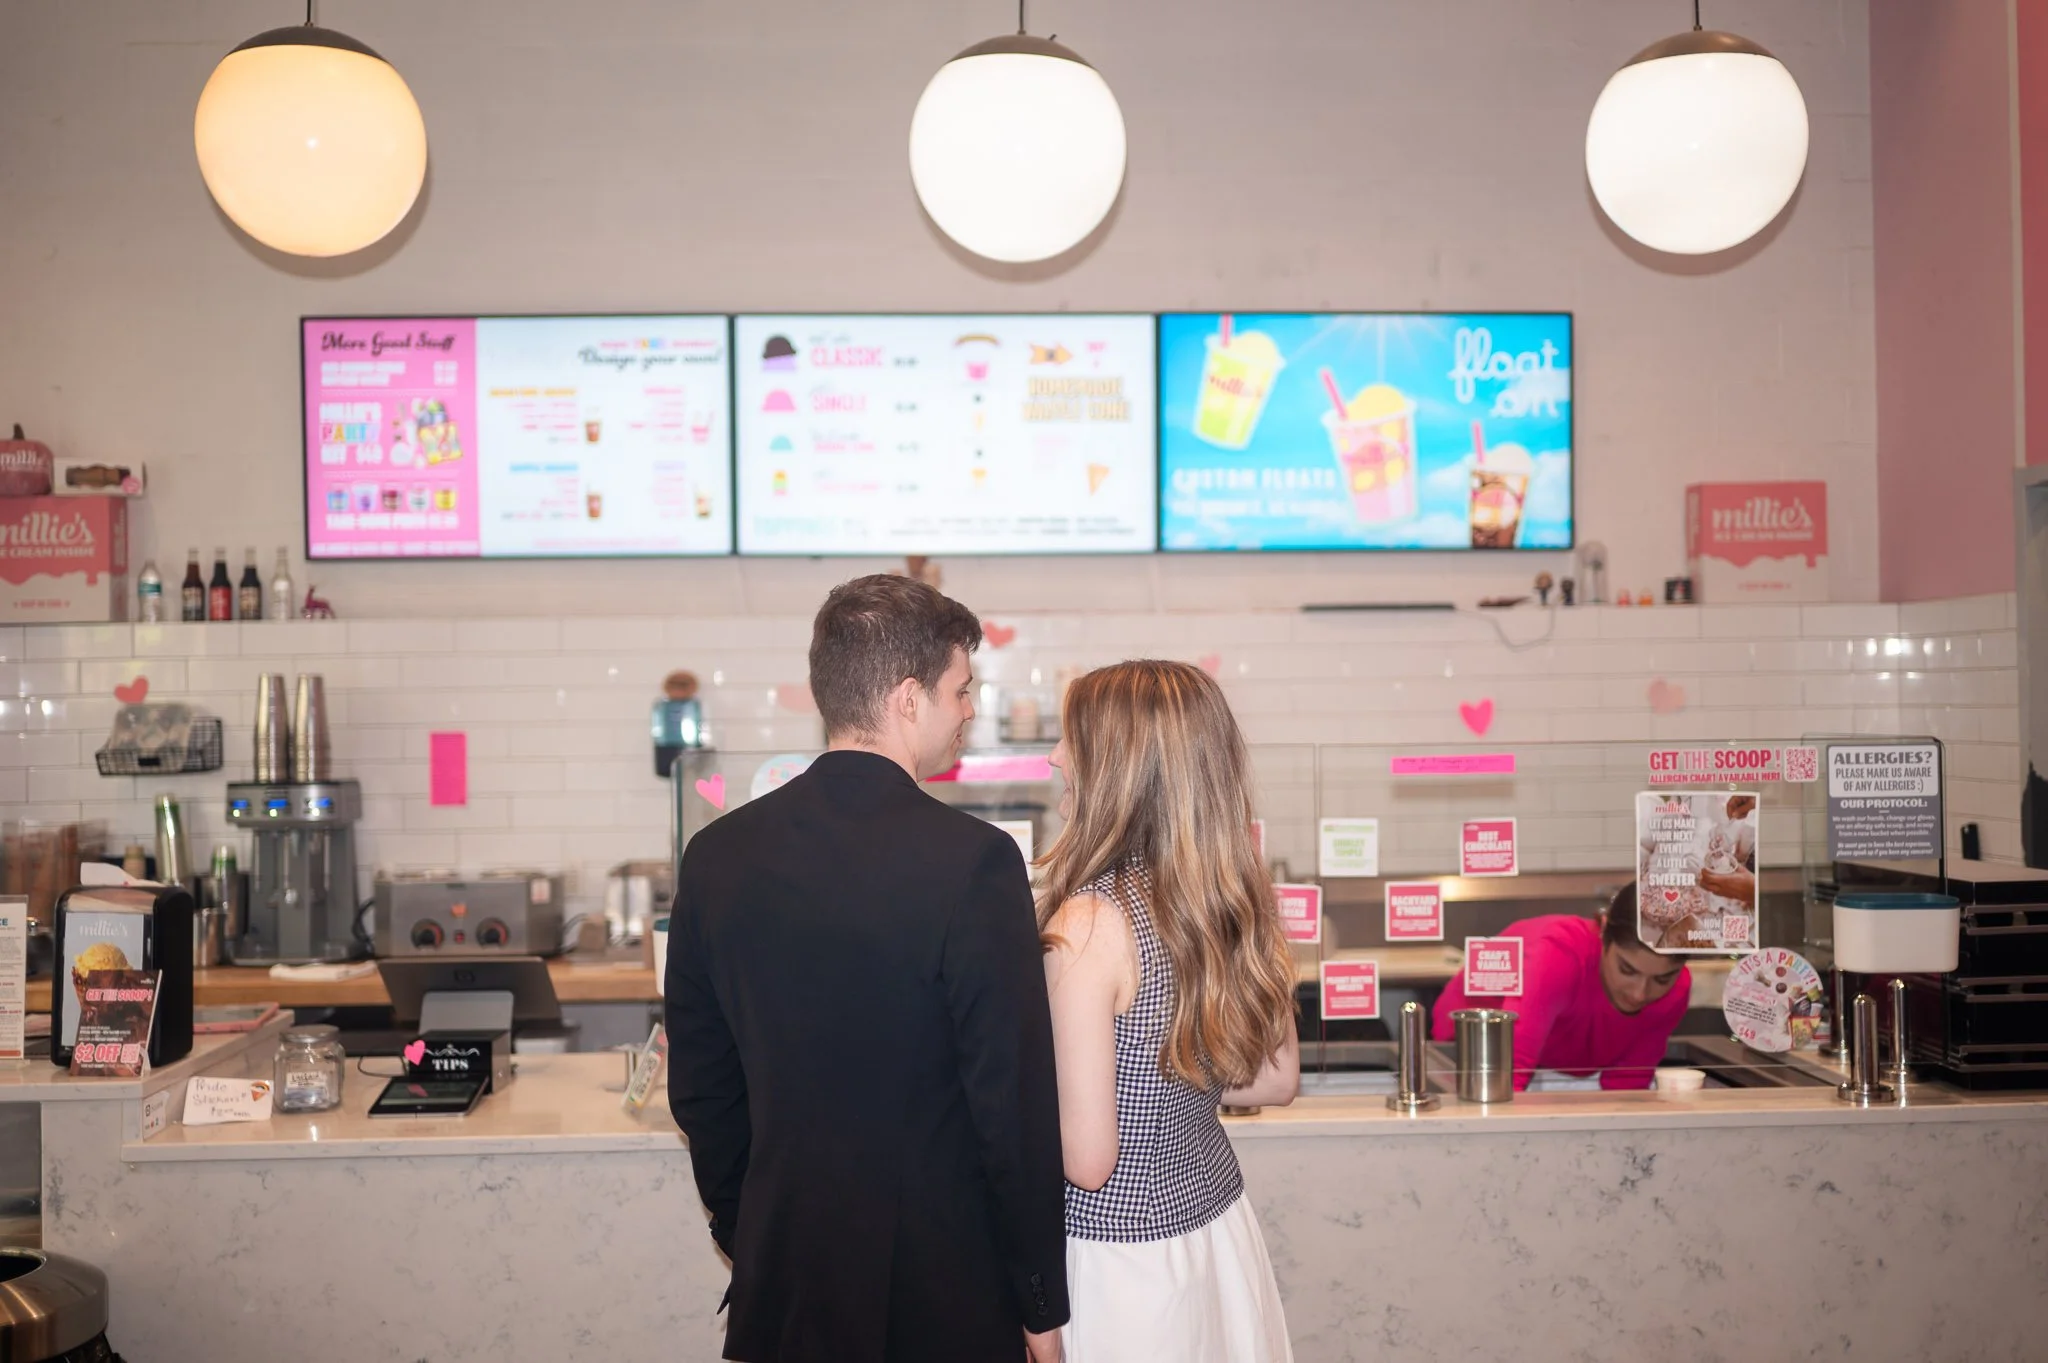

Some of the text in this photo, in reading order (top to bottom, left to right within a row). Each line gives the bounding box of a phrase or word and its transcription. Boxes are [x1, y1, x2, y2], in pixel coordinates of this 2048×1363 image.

[321, 332, 366, 351] More
[1447, 326, 1559, 404] float
[1712, 496, 1814, 529] millie's
[10, 547, 51, 558] CREAM
[1650, 752, 1679, 770] GET
[1683, 751, 1710, 769] THE
[1834, 751, 1932, 765] ALLERGIES?
[1835, 767, 1932, 779] PLEASE MAKE US AWARE
[1844, 781, 1854, 792] OF
[1855, 781, 1873, 791] ANY
[1874, 780, 1915, 791] ALLERGIES
[1840, 798, 1928, 809] OUR PROTOCOL:
[1662, 819, 1672, 829] US
[1674, 818, 1696, 829] MAKE
[1652, 831, 1694, 841] YOUR NEXT
[1465, 841, 1512, 852] CHOCOLATE
[1660, 844, 1682, 854] EVENT
[1649, 873, 1696, 886] SWEETER
[1391, 895, 1437, 906] BACKYARD
[79, 919, 129, 937] millie's
[1476, 960, 1512, 970] VANILLA
[1740, 955, 1761, 975] IT'S
[1766, 952, 1773, 964] A
[75, 1043, 95, 1063] $2
[95, 1044, 122, 1062] OFF
[432, 1059, 469, 1070] TIPS
